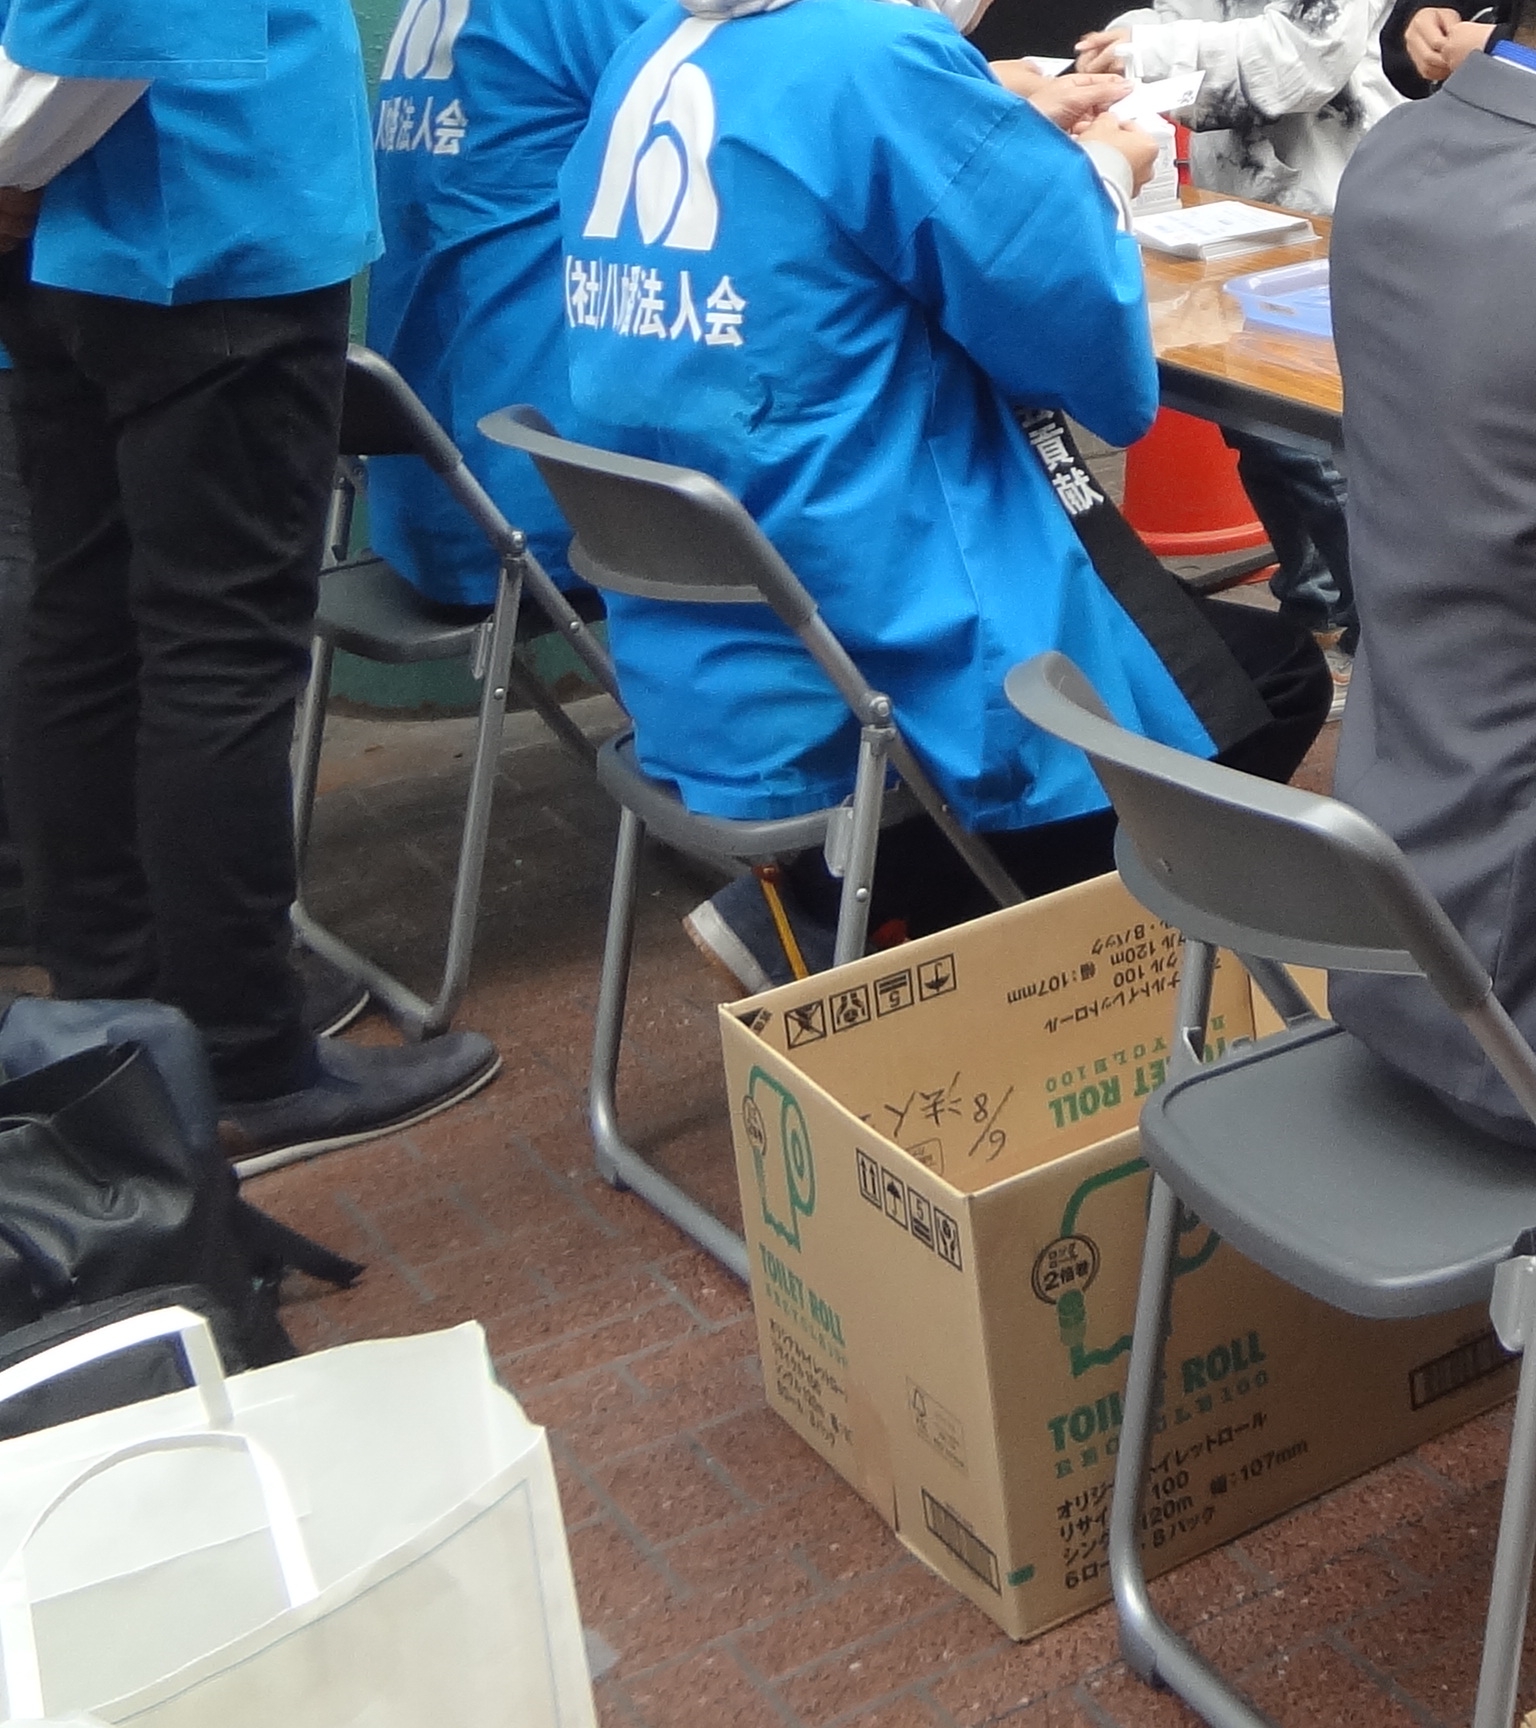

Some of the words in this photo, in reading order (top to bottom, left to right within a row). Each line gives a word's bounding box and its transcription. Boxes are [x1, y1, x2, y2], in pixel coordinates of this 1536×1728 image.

[860, 1071, 961, 1138] 法人
[1048, 1075, 1122, 1129] ROLL
[808, 1286, 847, 1350] ROLL
[1181, 1331, 1267, 1394] ROLL
[1151, 1470, 1190, 1500] 100
